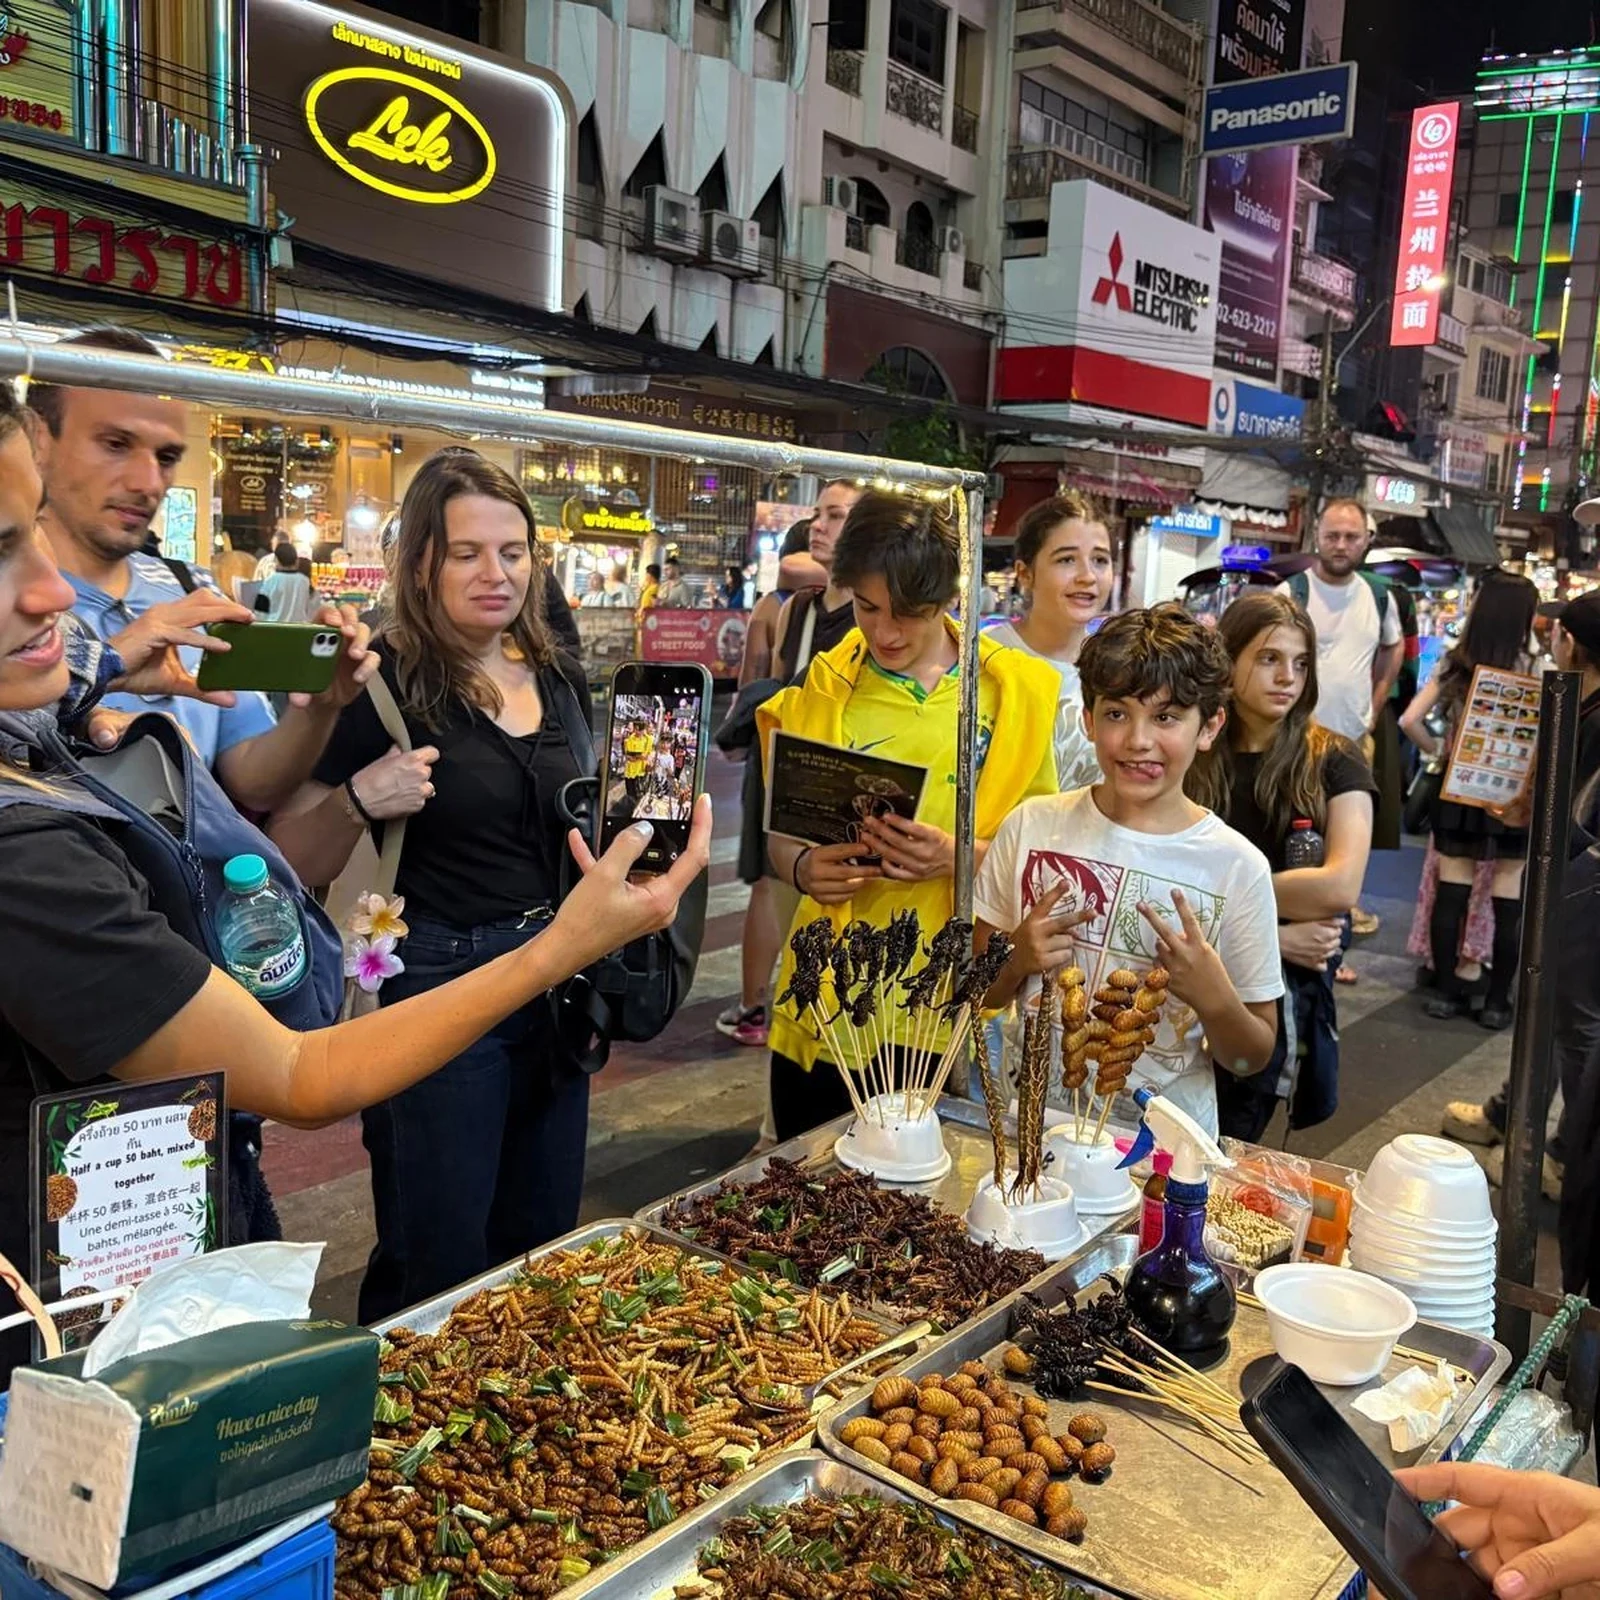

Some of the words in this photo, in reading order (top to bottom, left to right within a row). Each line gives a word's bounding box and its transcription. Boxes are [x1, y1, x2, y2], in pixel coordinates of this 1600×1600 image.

[1210, 91, 1341, 132] Panasonic
[347, 96, 452, 172] Lek
[1134, 259, 1209, 309] MITSUBISHI
[1133, 288, 1198, 333] ELECTRIC
[1217, 303, 1276, 339] 02-623-2212
[79, 1124, 120, 1142] ครึ่งถ้วย
[123, 1120, 138, 1133] 50
[141, 1116, 162, 1130] บาท
[165, 1111, 188, 1124] ผสม
[126, 1137, 142, 1150] กัน
[70, 1163, 91, 1176] Half
[95, 1162, 101, 1170] a
[105, 1158, 122, 1169] cup
[126, 1153, 137, 1163] 50
[141, 1148, 164, 1160] baht,
[167, 1140, 195, 1154] mixed
[115, 1173, 155, 1189] together
[79, 1226, 102, 1238] Une
[104, 1210, 160, 1232] demi-tasse
[163, 1207, 170, 1217] à
[172, 1203, 185, 1213] 50
[92, 1206, 107, 1218] 50
[87, 1236, 120, 1252] bahts,
[123, 1221, 178, 1243] mélangée.
[134, 1244, 147, 1254] Do
[148, 1239, 164, 1250] not
[165, 1234, 187, 1245] taste
[83, 1271, 96, 1282] Do
[98, 1266, 114, 1277] not
[115, 1258, 141, 1271] touch
[216, 1416, 254, 1440] Have
[254, 1413, 266, 1429] a
[266, 1403, 294, 1425] nice
[294, 1394, 319, 1416] day
